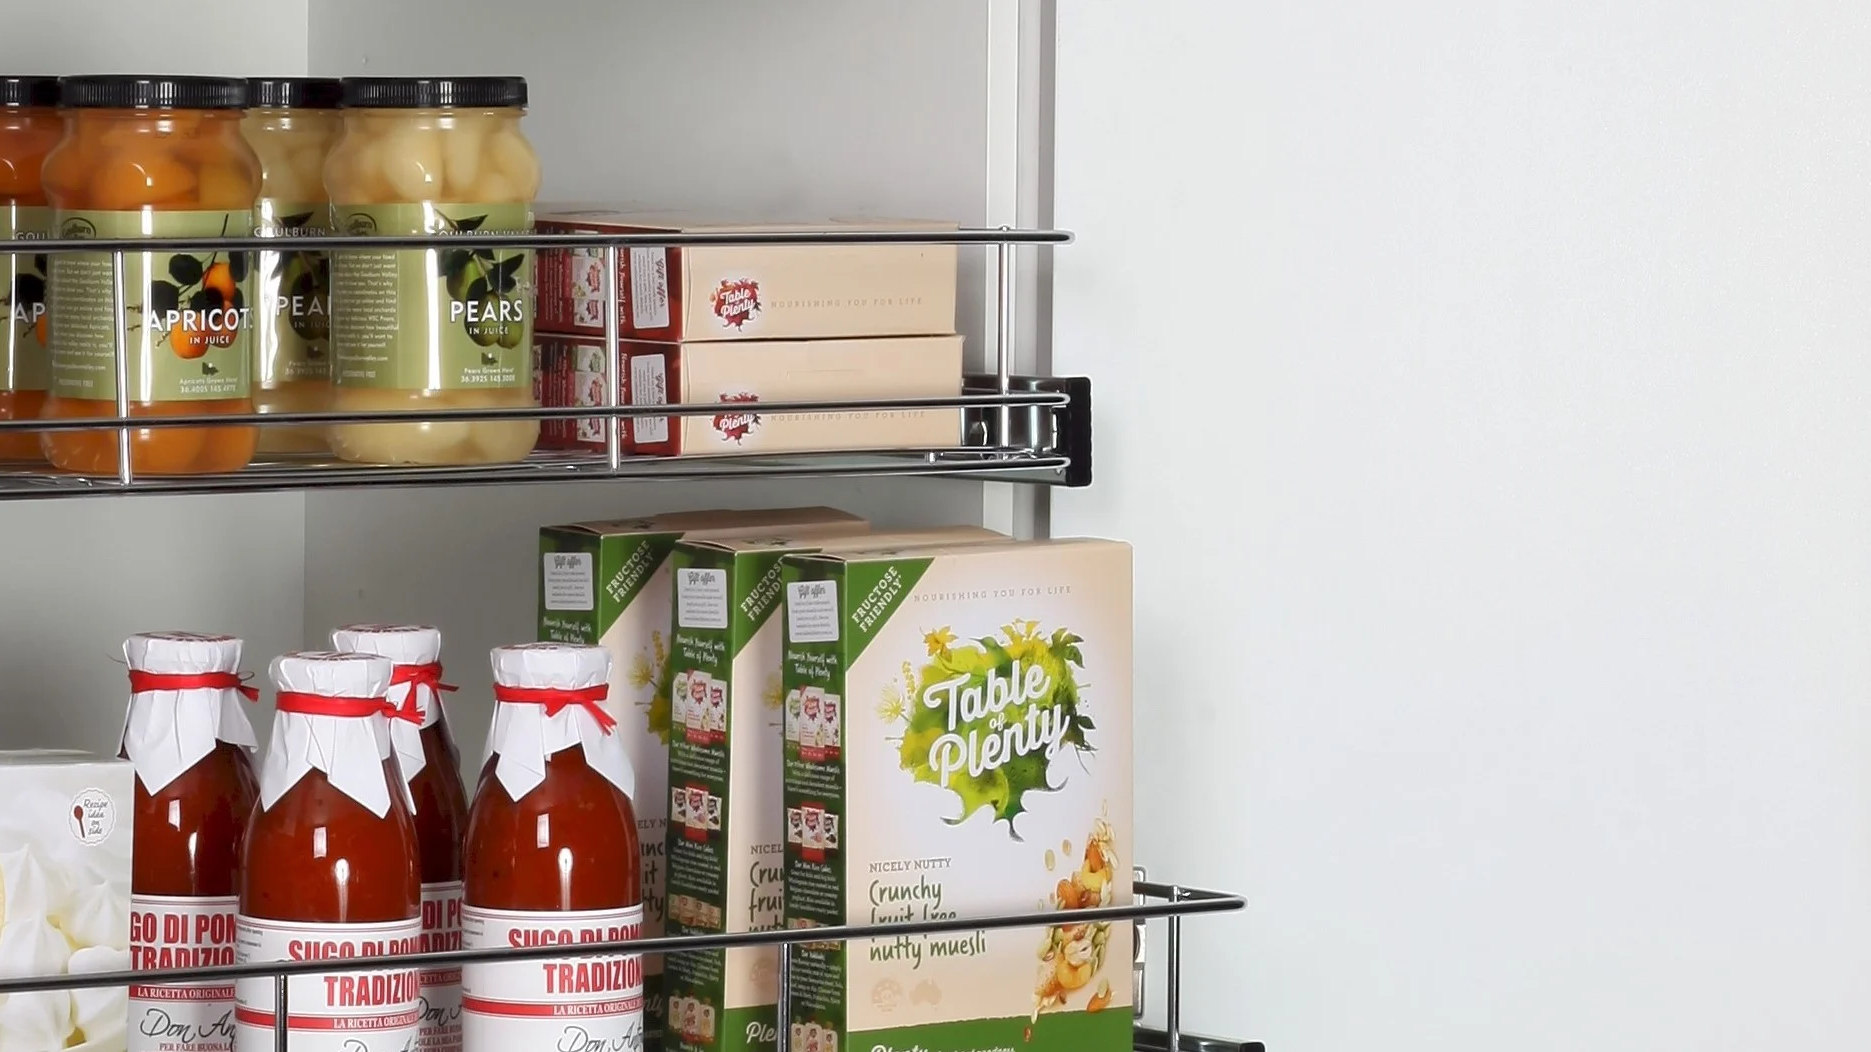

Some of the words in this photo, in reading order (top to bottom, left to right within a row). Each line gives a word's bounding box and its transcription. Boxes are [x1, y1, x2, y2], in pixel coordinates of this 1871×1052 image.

[720, 287, 751, 303] Table
[771, 301, 841, 309] NOURISHING
[899, 297, 923, 305] LIFE
[449, 300, 524, 323] PEARS
[720, 299, 756, 318] Plenty
[189, 336, 201, 345] IN
[204, 336, 230, 345] JUICE
[469, 327, 479, 336] IN
[483, 326, 510, 336] JUICE
[606, 540, 650, 595] FRUCTOSE
[612, 551, 655, 603] FRIENDLY
[851, 565, 898, 624] FRUCTOSE
[914, 591, 988, 603] NOURISHING
[993, 588, 1015, 598] YOU
[1021, 587, 1042, 597] FOR
[1047, 585, 1072, 595] LIFE
[923, 659, 1050, 731] Table
[990, 713, 1006, 730] of
[929, 704, 1070, 788] Plenty
[869, 861, 911, 873] NICELY
[914, 858, 952, 870] NUTTY
[869, 875, 942, 911] Crunchy
[422, 901, 443, 930] DI
[164, 914, 189, 945] DI
[508, 928, 573, 948] SUGO
[288, 940, 355, 961] SUGO
[870, 936, 922, 970] nutty
[930, 930, 986, 957] muesli
[137, 987, 149, 997] LA
[149, 987, 188, 998] RICETTA
[553, 1005, 565, 1015] LA
[567, 1004, 603, 1016] RICETTA
[140, 1008, 197, 1043] Don
[333, 1018, 347, 1029] LA
[348, 1017, 382, 1029] RICETTA
